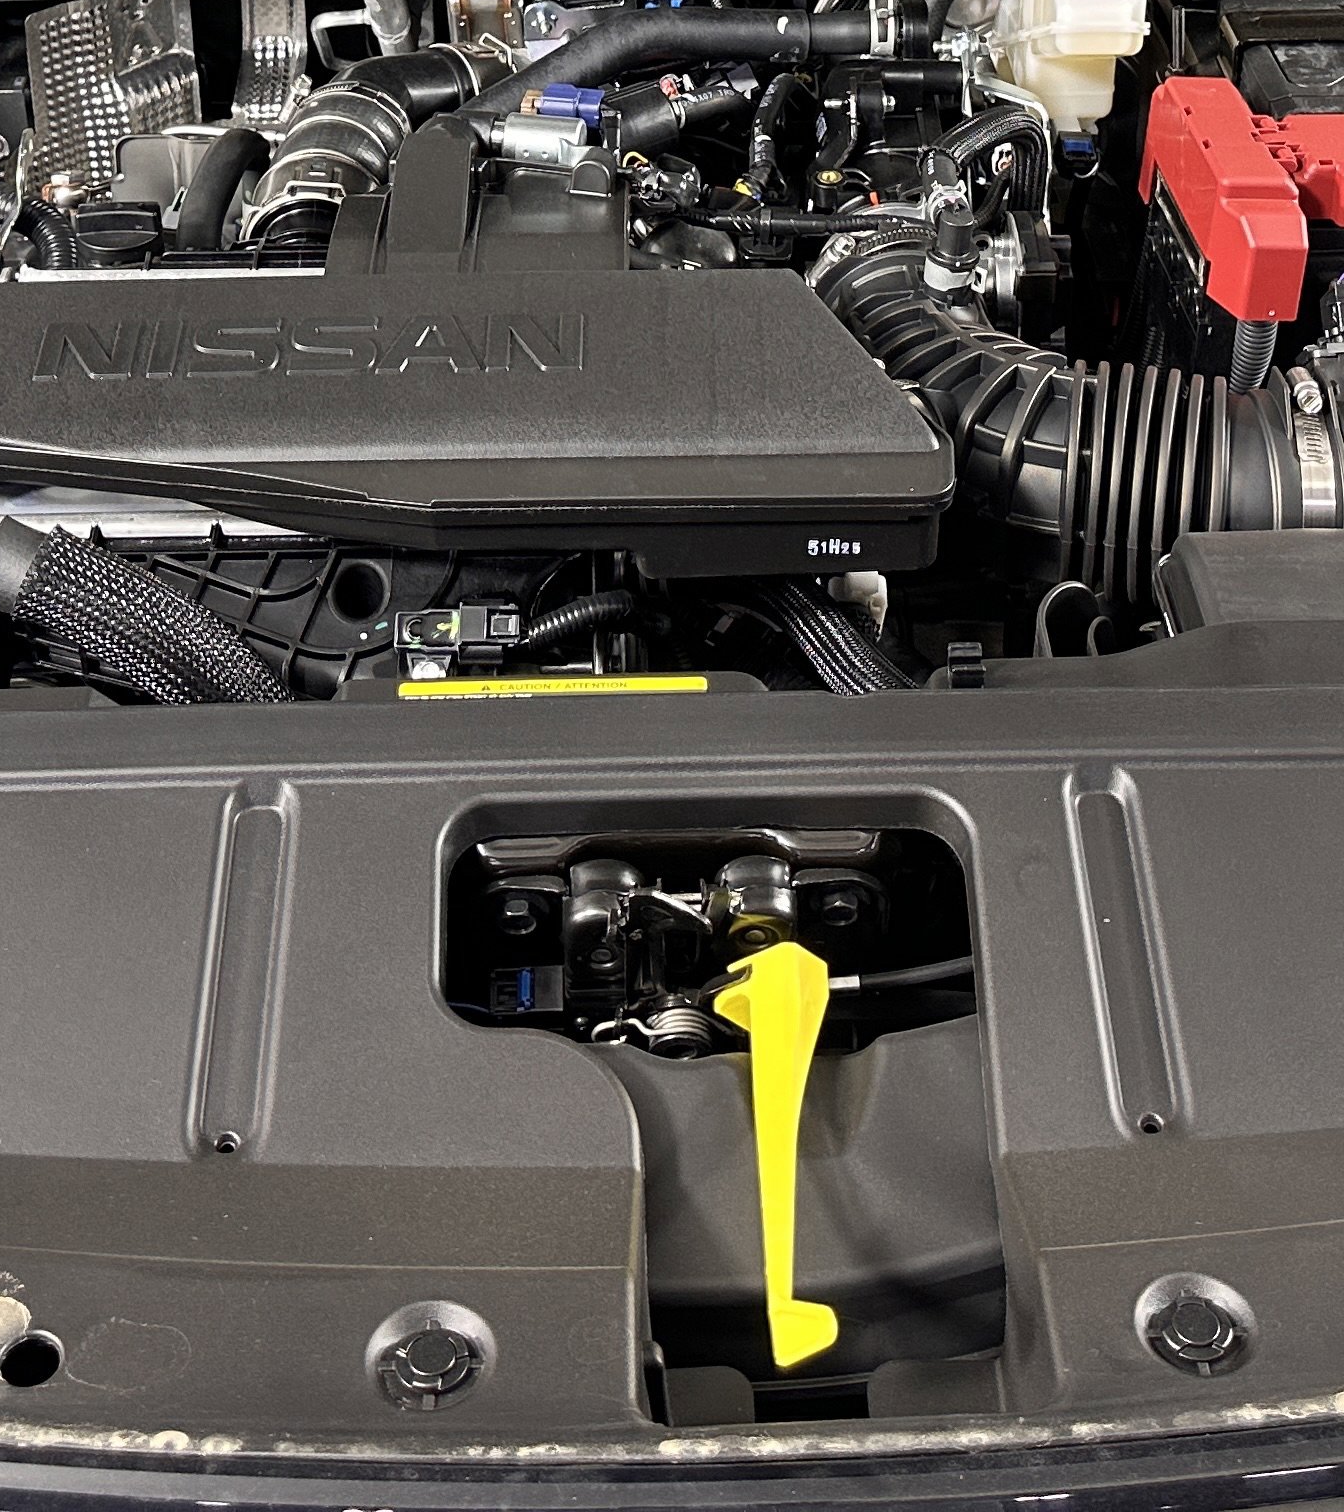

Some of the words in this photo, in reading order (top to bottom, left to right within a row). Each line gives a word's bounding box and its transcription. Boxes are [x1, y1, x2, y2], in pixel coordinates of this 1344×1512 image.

[32, 314, 584, 381] NISSAN
[499, 683, 551, 691] CAUTION
[564, 682, 628, 690] ATTENTION
